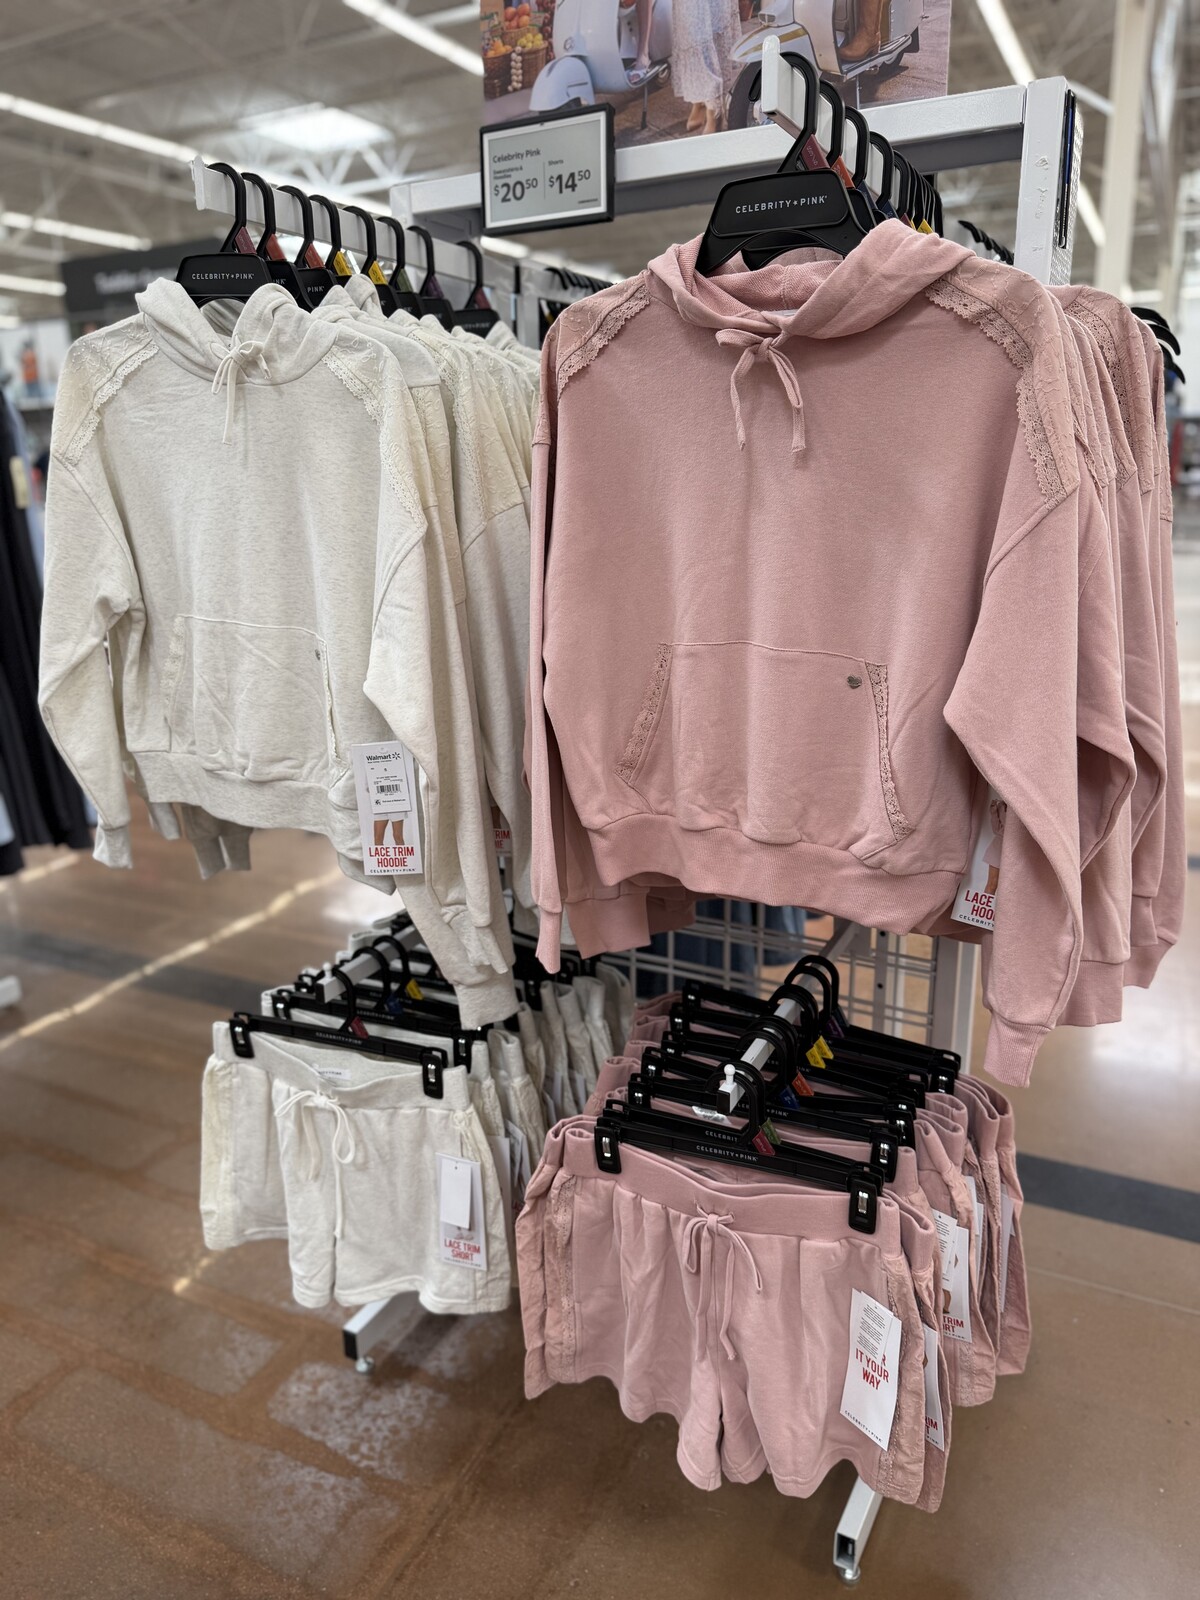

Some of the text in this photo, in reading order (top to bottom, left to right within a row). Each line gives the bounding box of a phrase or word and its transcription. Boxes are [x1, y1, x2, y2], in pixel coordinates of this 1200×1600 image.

[493, 148, 541, 164] Celebrity Pink
[735, 195, 826, 213] CELEBRITY PINK
[368, 846, 415, 857] LACE TRIM
[377, 857, 408, 868] HOODIE
[965, 890, 994, 907] LACE
[705, 1130, 738, 1142] CELEBRIT
[696, 1145, 758, 1161] CELEBRITY PINK
[444, 1239, 481, 1254] LACE TRIM
[451, 1249, 473, 1262] SHORT
[855, 1347, 864, 1363] IT
[866, 1355, 889, 1383] YOUR
[862, 1367, 881, 1390] WAY
